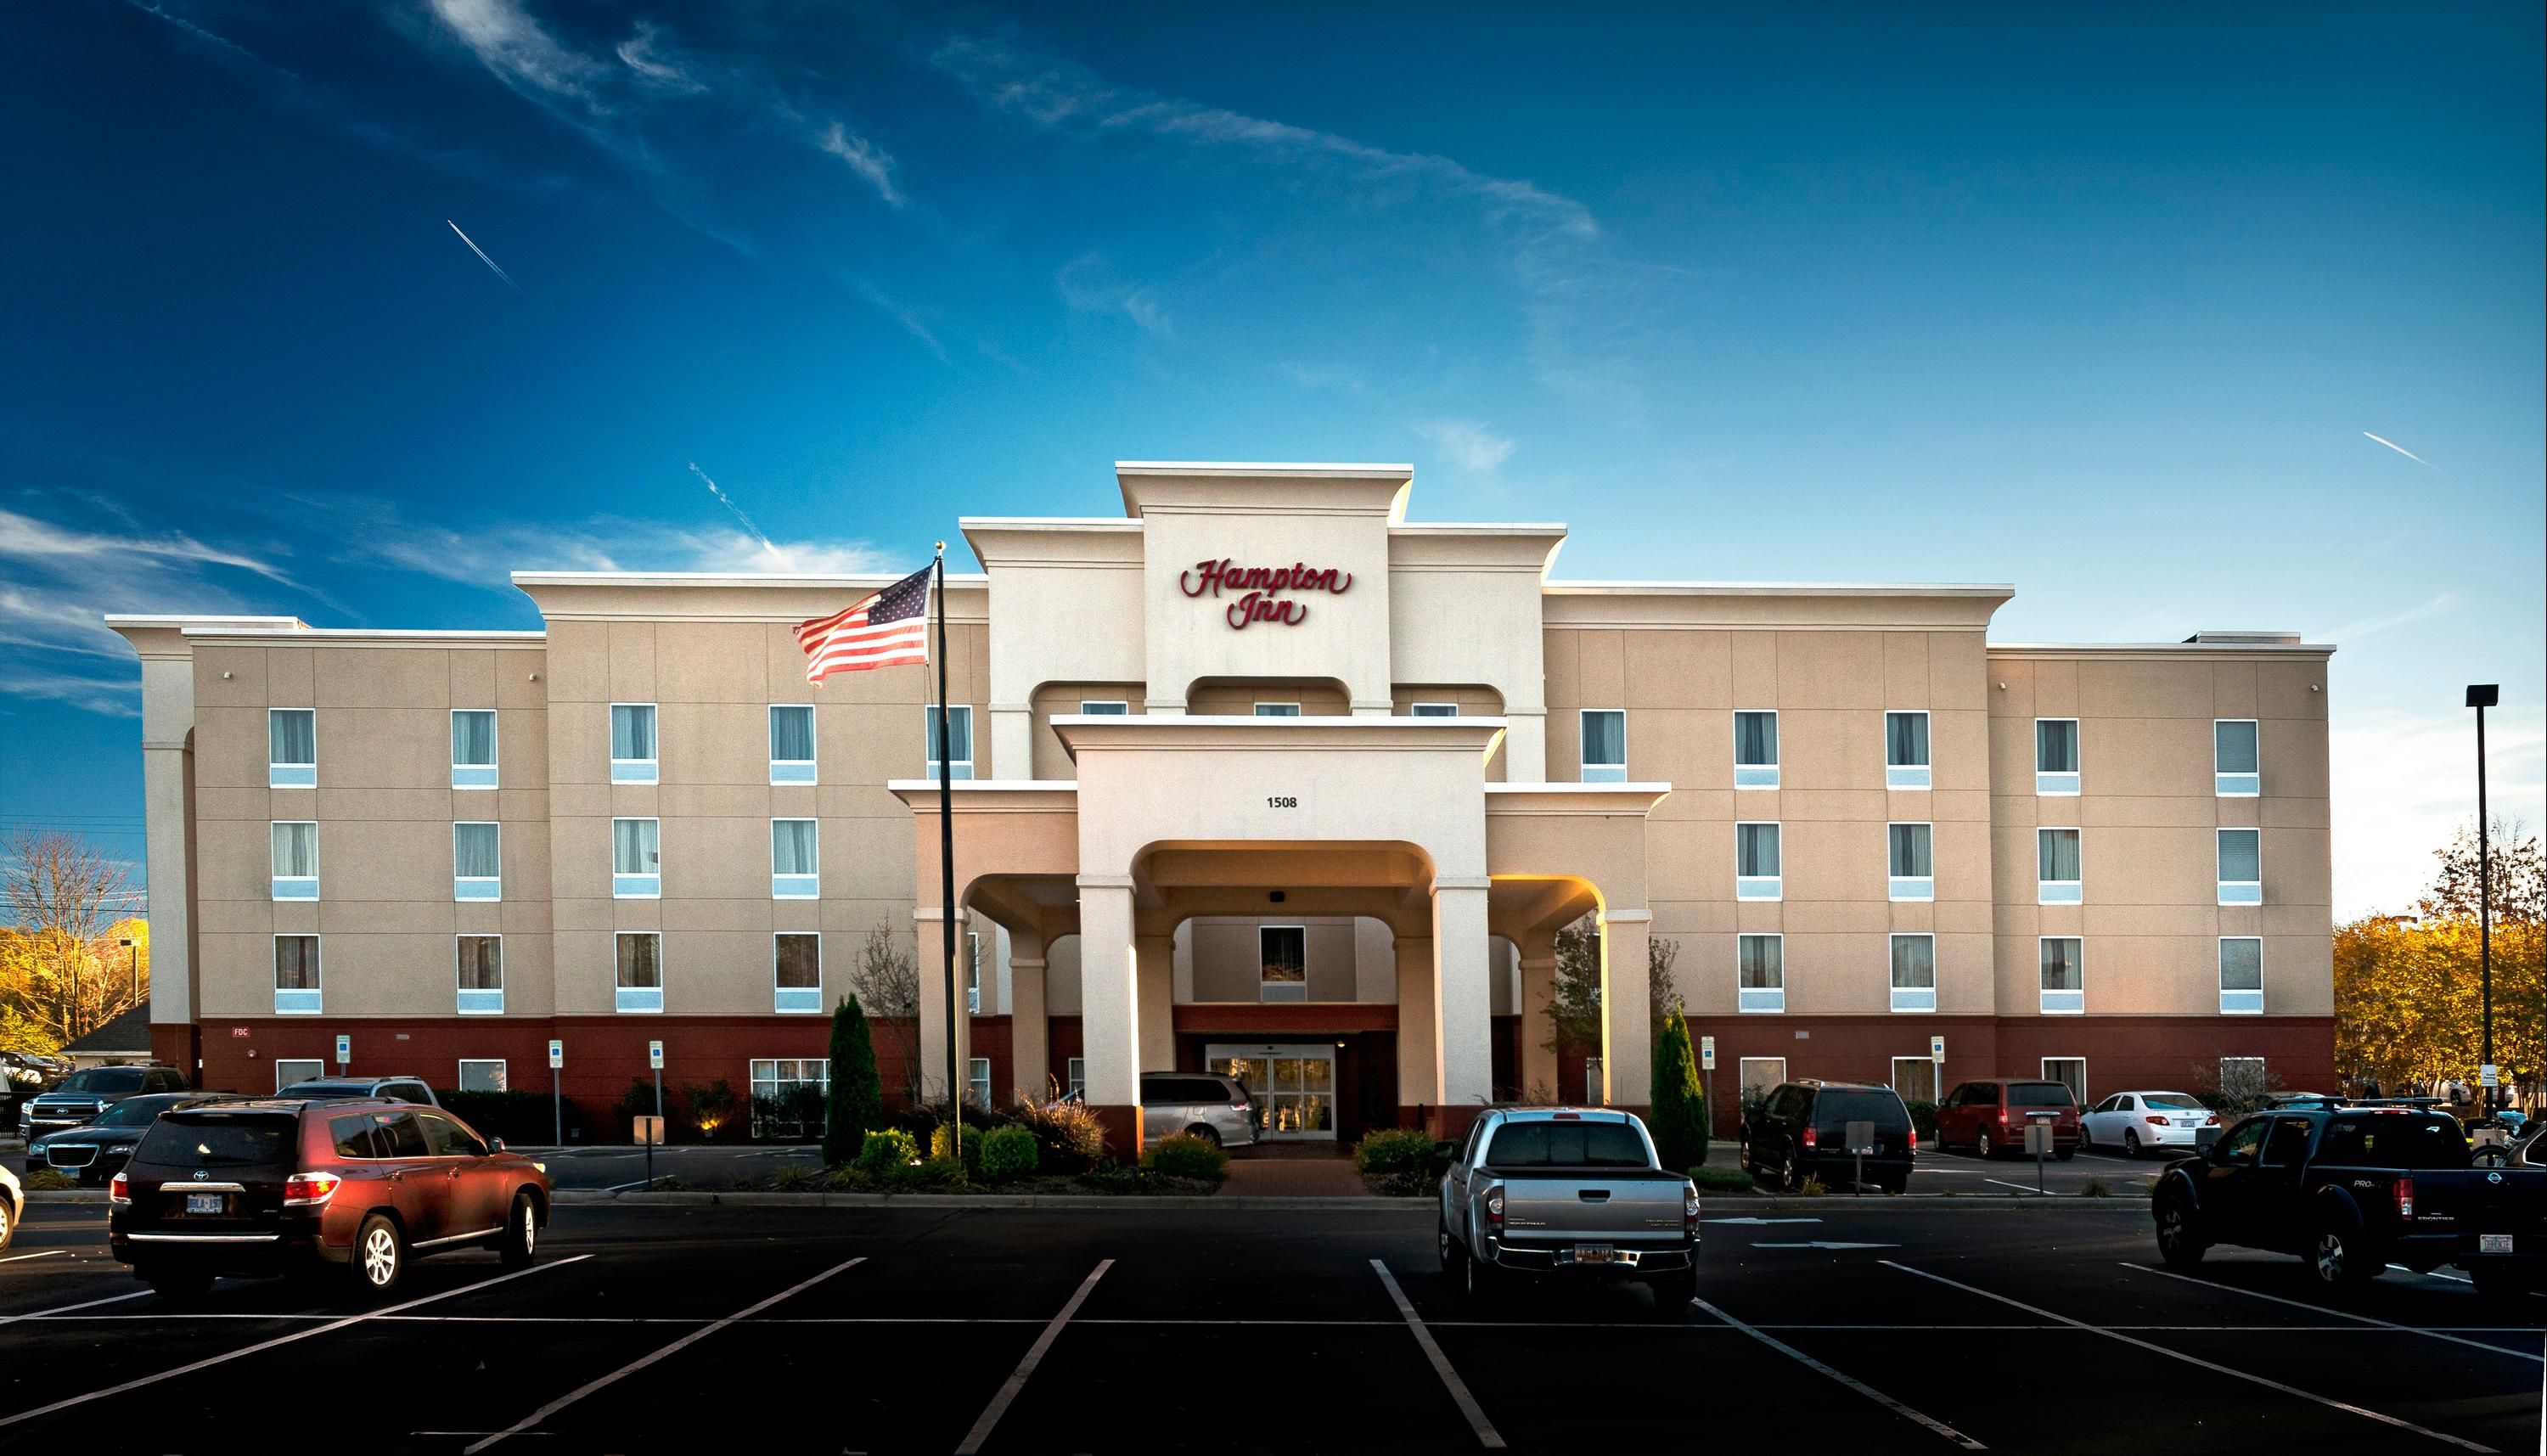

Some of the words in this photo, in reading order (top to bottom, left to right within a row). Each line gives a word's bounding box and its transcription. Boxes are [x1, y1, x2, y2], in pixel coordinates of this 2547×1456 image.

[1181, 558, 1352, 598] Hampton
[1227, 592, 1307, 630] Inn
[1267, 797, 1297, 807] 1508
